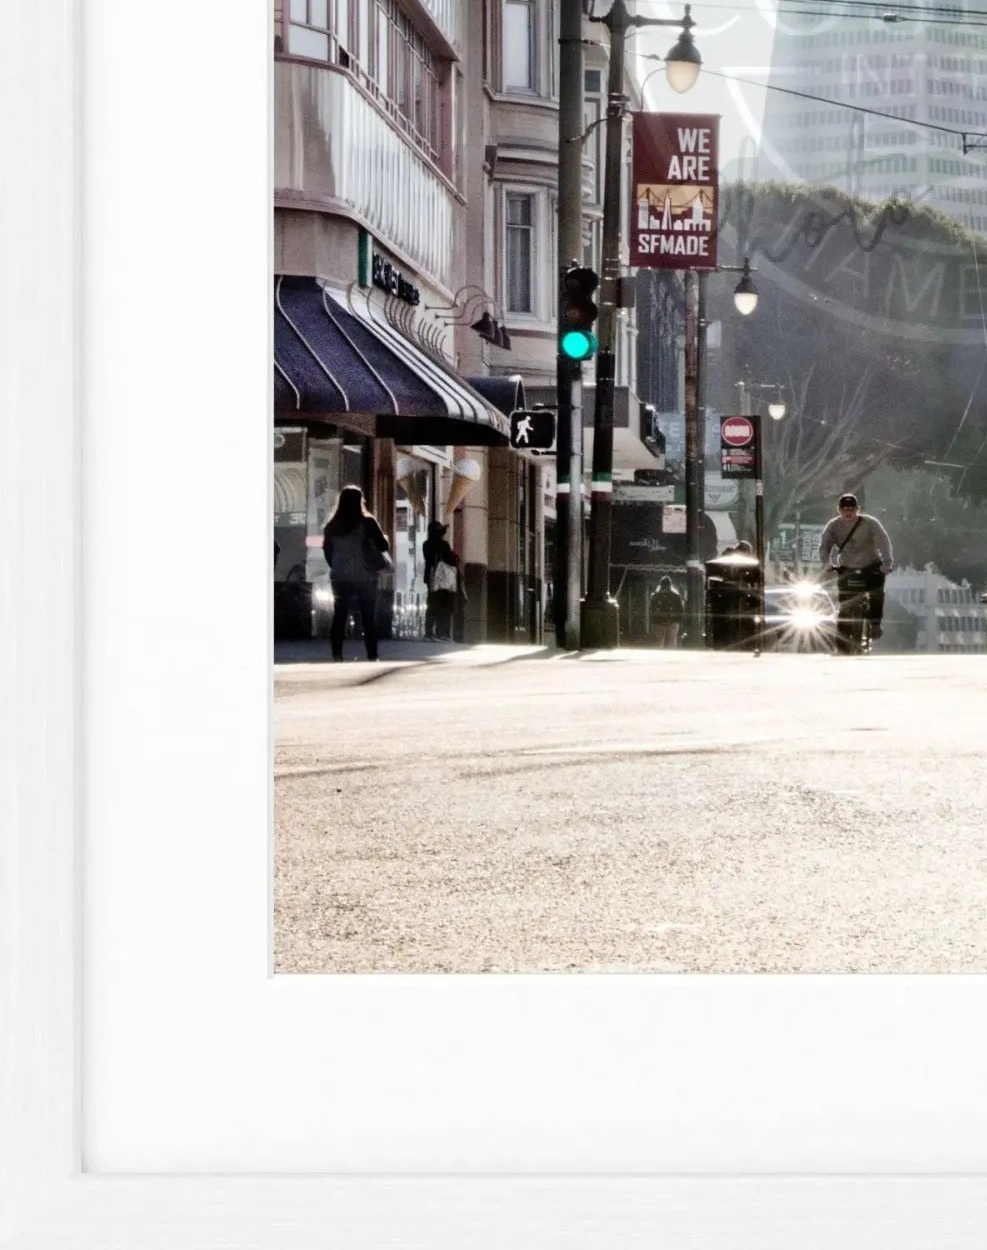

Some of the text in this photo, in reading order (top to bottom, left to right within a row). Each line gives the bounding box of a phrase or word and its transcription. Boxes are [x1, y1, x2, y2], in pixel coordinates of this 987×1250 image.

[677, 127, 711, 154] WE
[667, 155, 710, 181] ARE
[637, 233, 709, 257] SFMADE
